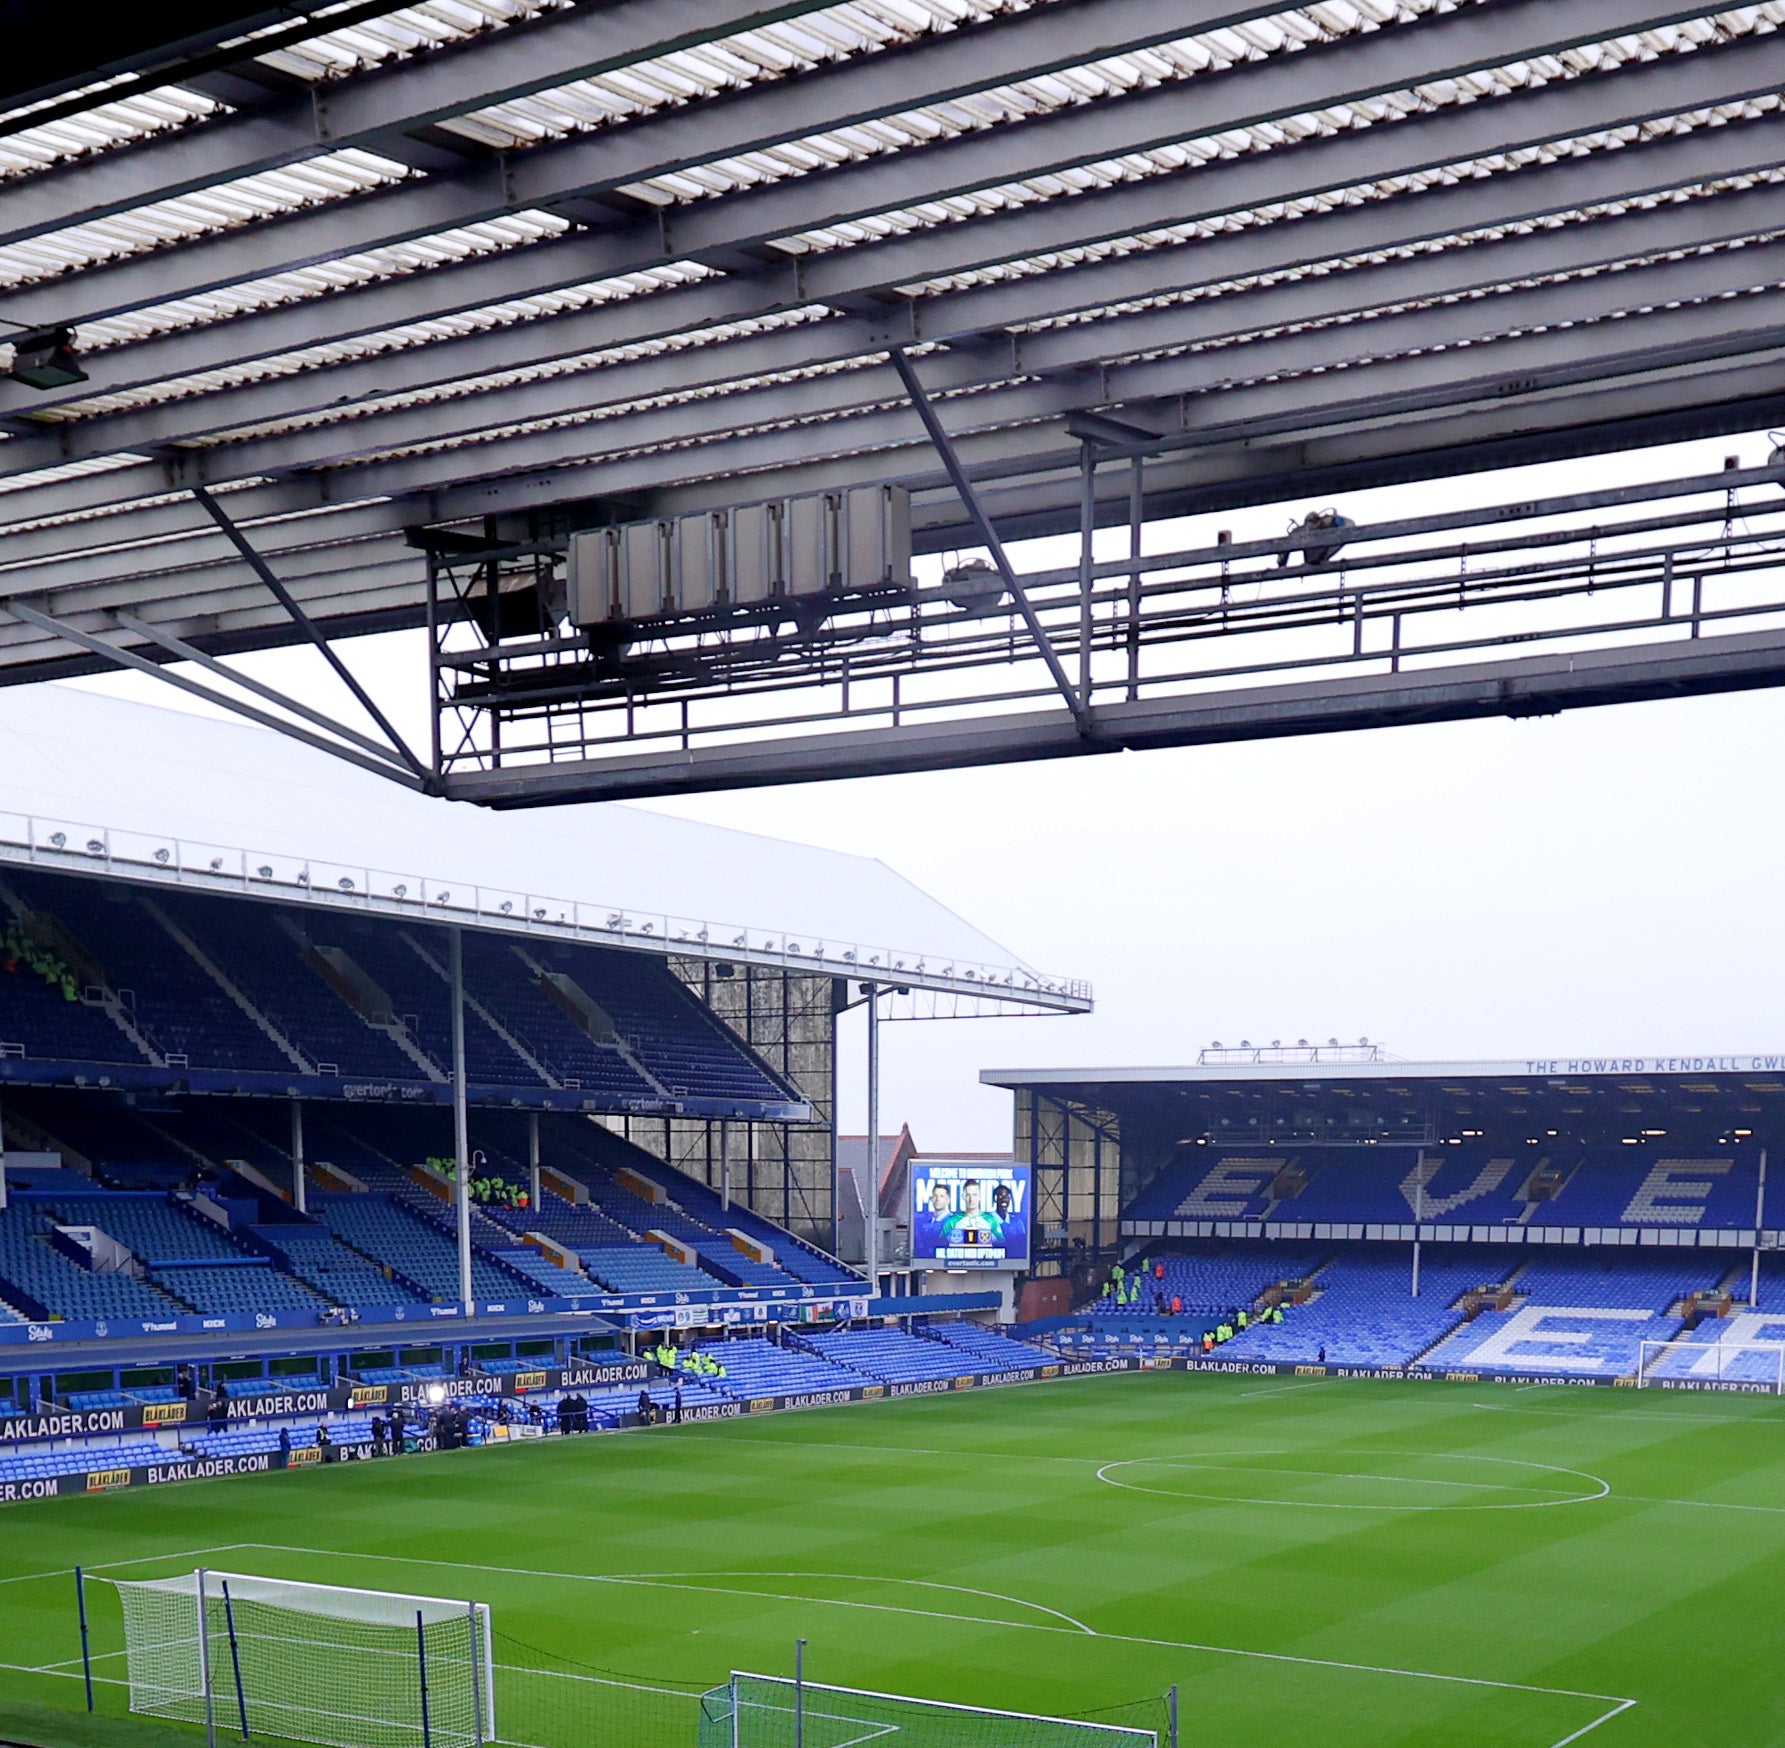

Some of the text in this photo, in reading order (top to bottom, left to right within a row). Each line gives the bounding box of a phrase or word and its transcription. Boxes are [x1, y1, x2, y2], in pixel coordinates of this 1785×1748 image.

[1525, 1060, 1558, 1074] THE
[1568, 1058, 1646, 1073] HOWARD
[1655, 1056, 1741, 1072] KENDALL
[561, 1364, 648, 1386] BLAKLADER.COM
[1063, 1359, 1128, 1375] BLAKLADER.COM
[1186, 1360, 1277, 1375] BLAKLADER.COM
[890, 1380, 949, 1397] BLAKLADER.COM
[784, 1390, 851, 1410] BLAKLADER.COM
[147, 1454, 269, 1484] BLAKLADER.COM
